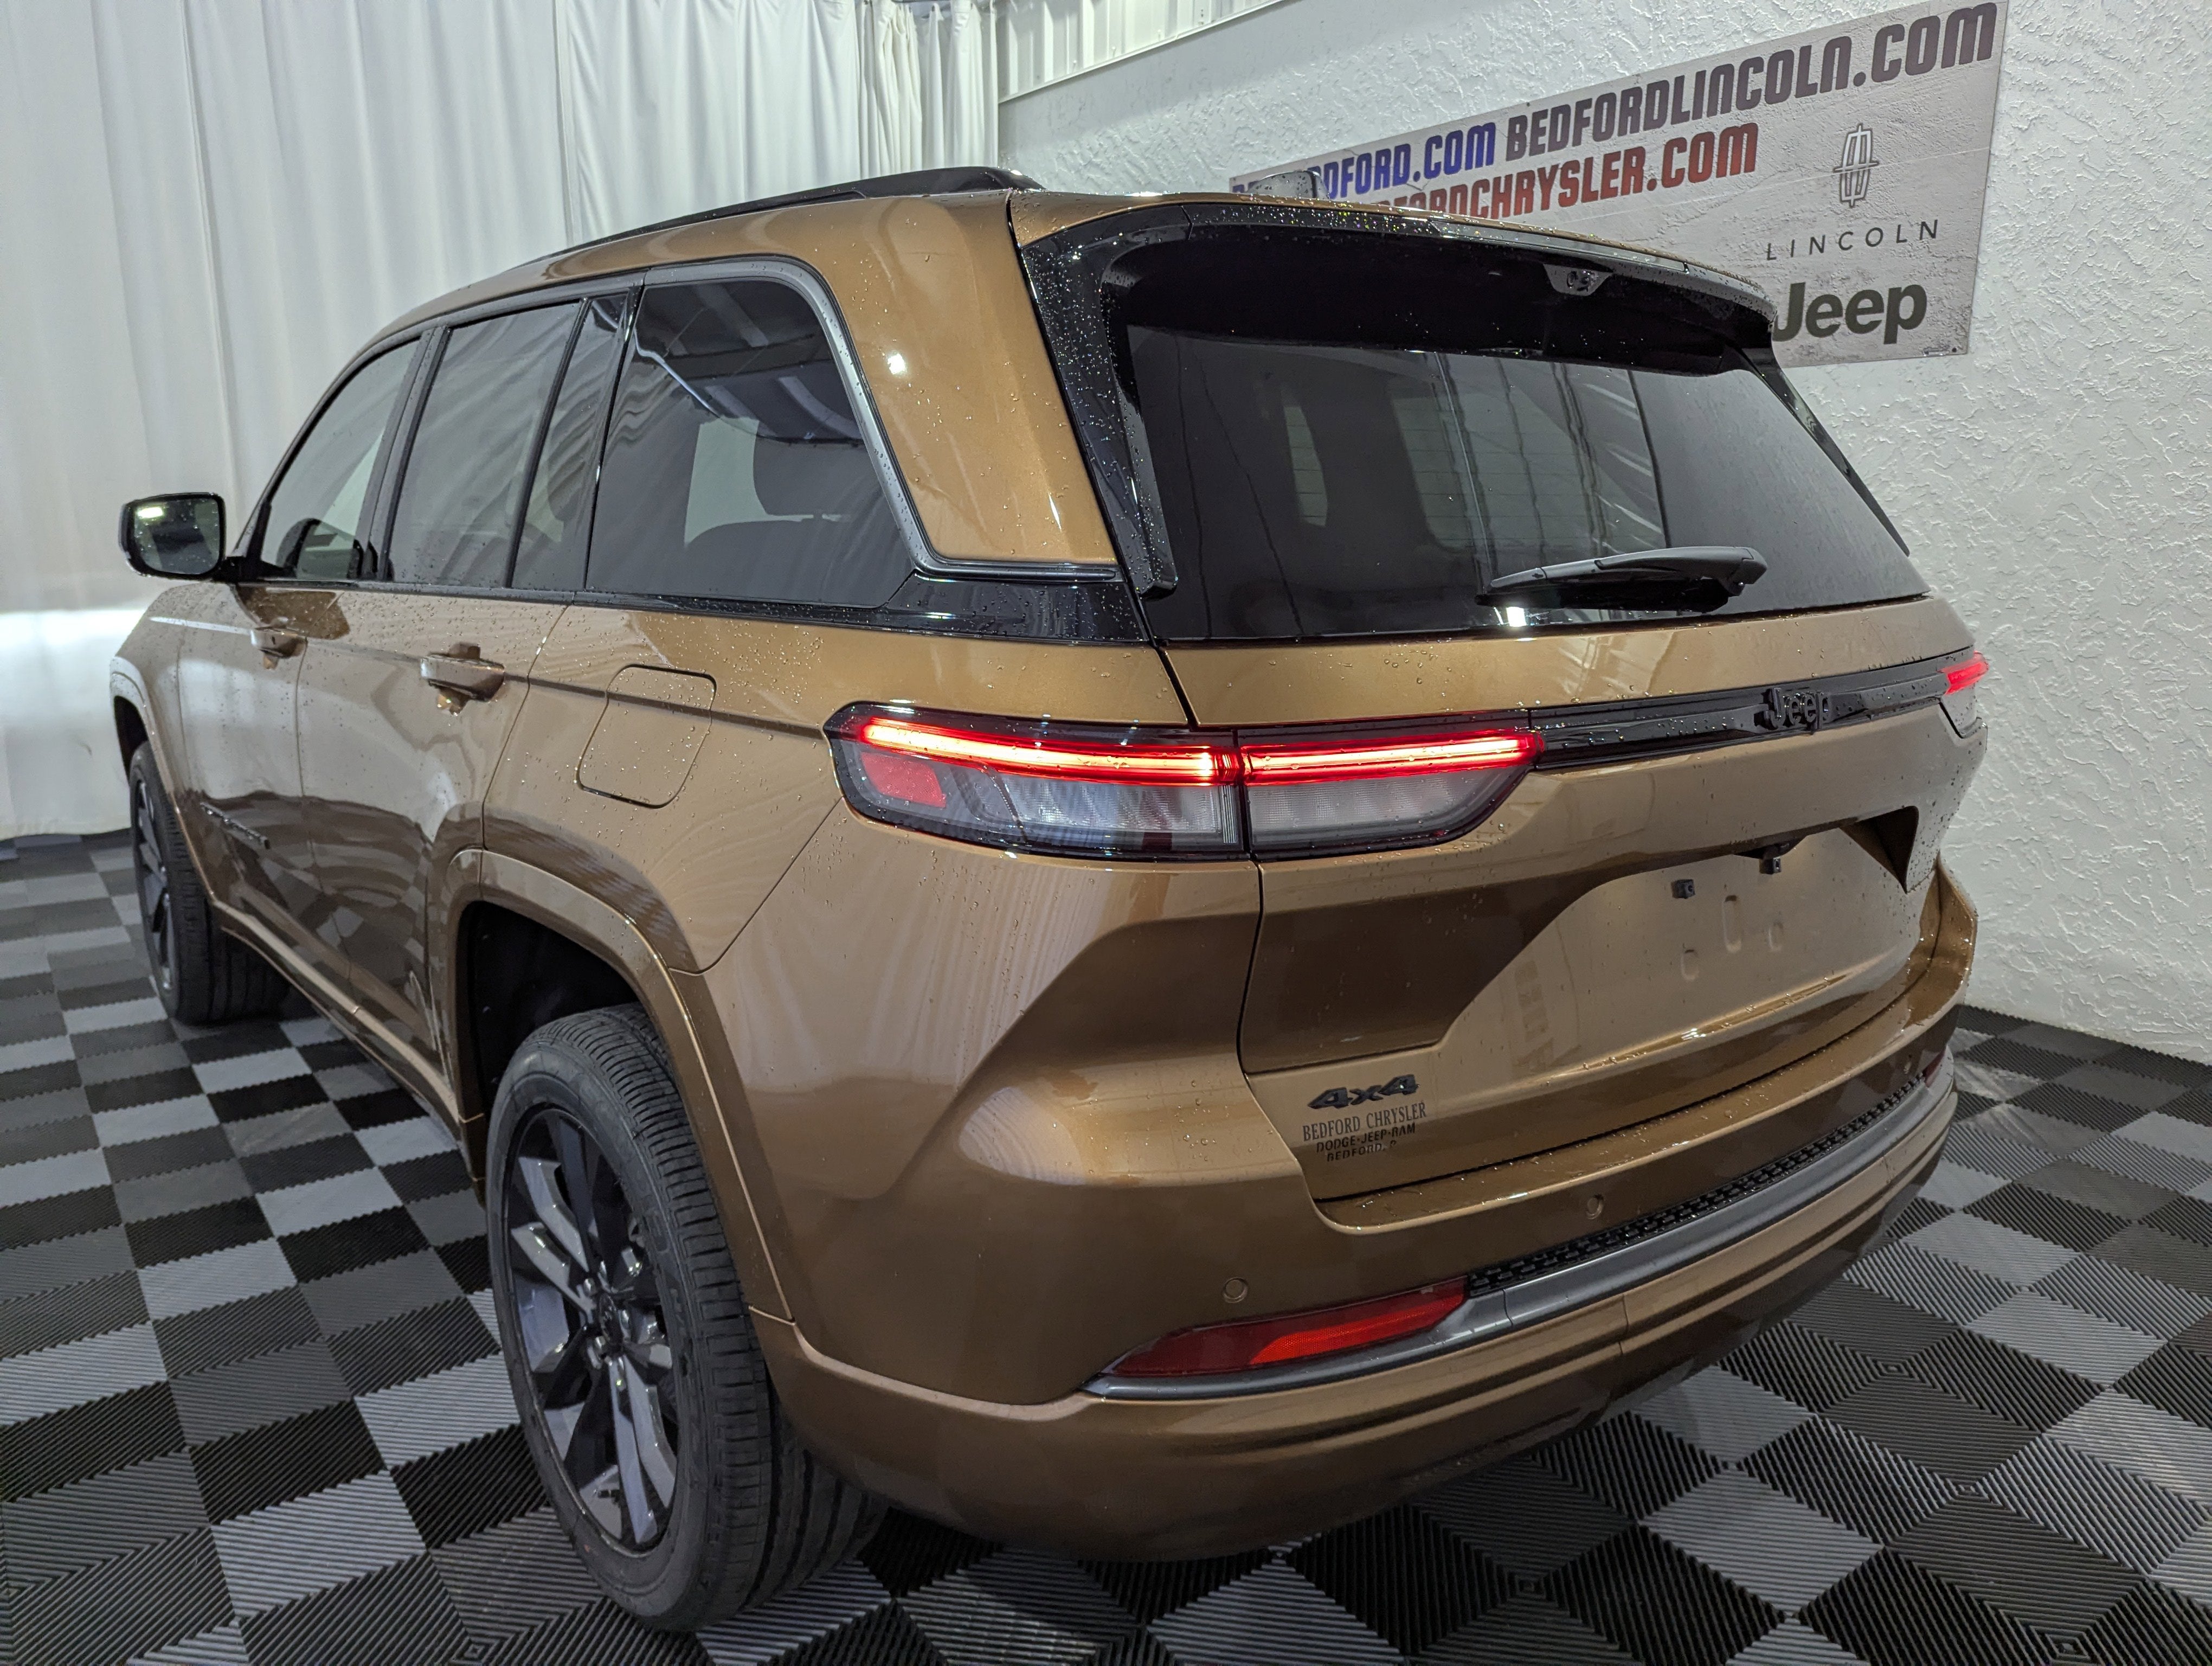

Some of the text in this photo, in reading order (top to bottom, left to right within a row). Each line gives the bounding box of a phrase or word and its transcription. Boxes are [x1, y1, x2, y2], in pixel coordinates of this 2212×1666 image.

[1506, 2, 1996, 161] BEDFORDLINCOLN.COM
[1766, 219, 1938, 261] LINCOLN
[1772, 282, 1927, 344] Jeep
[1763, 687, 1830, 729] Jeep
[1303, 1101, 1426, 1141] BEDFORD CHRYSLER
